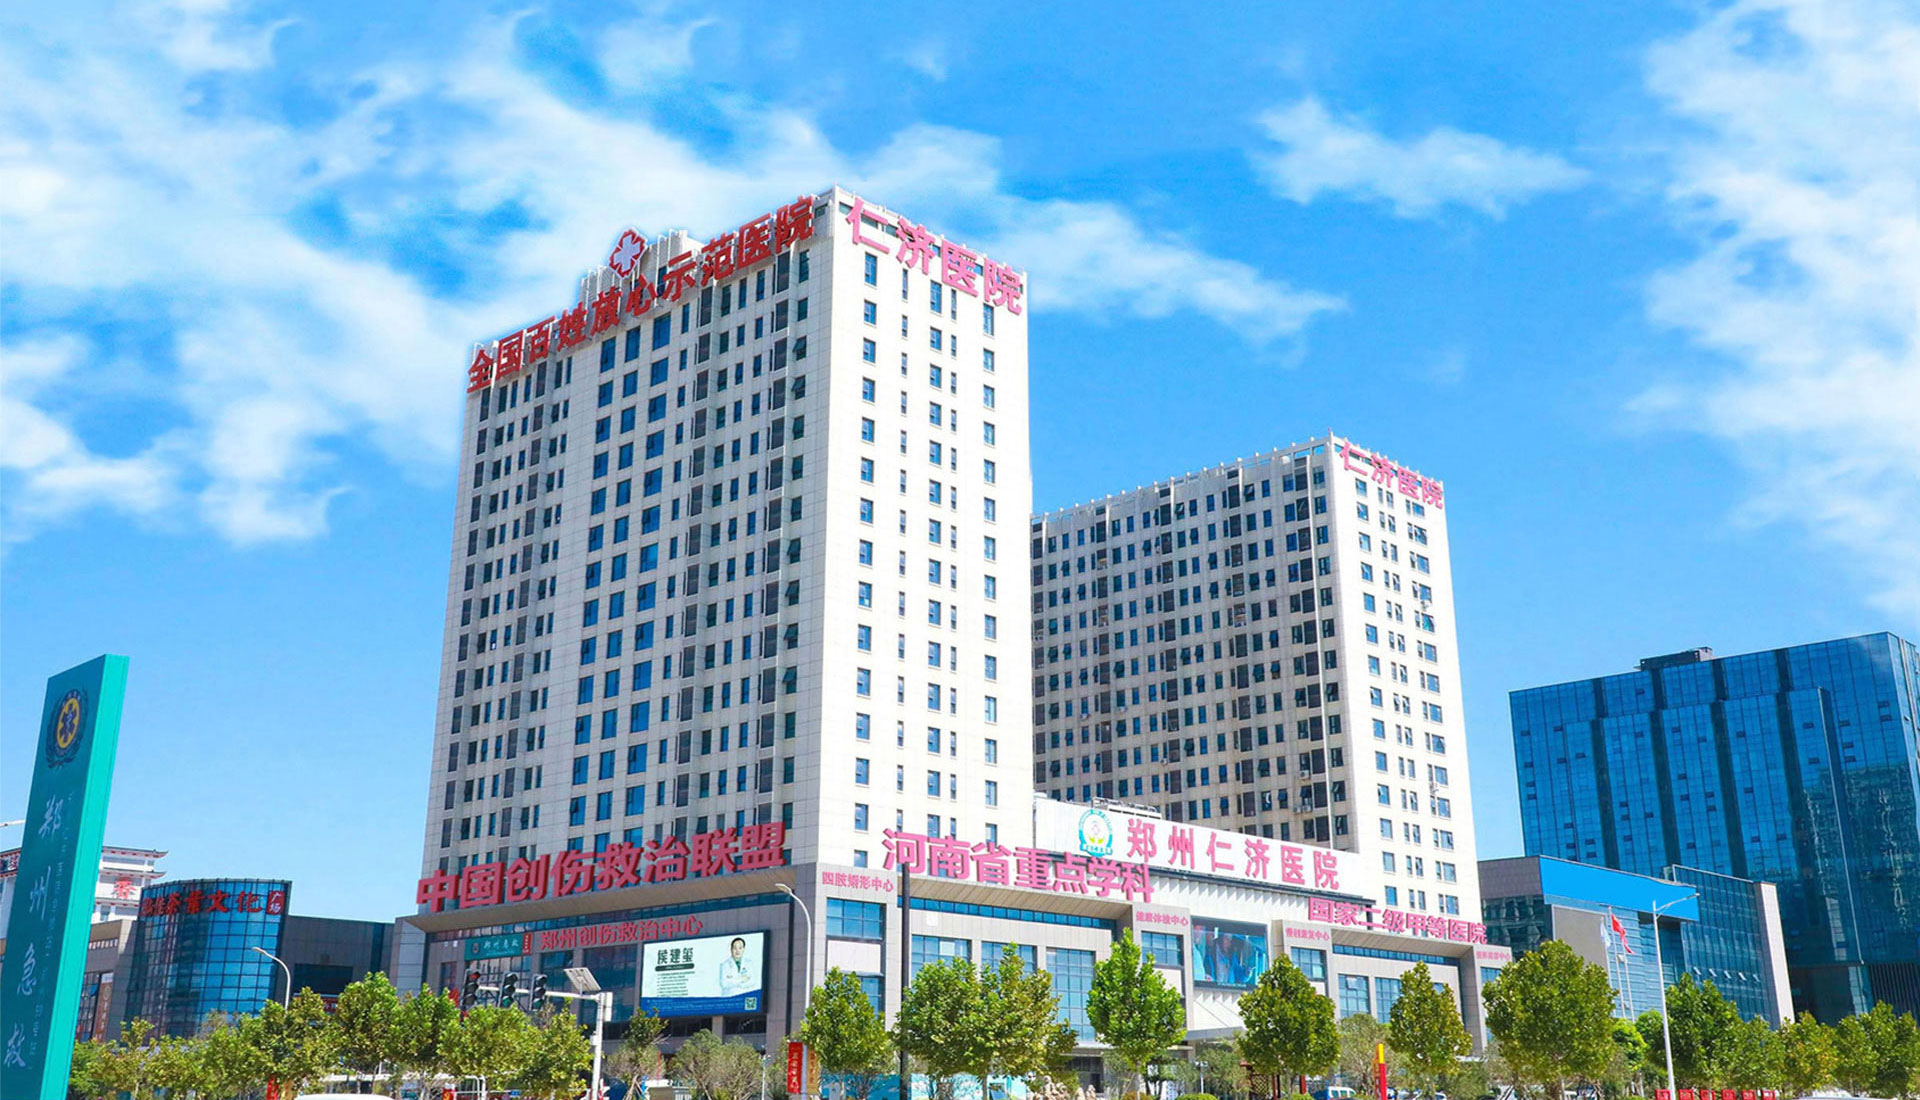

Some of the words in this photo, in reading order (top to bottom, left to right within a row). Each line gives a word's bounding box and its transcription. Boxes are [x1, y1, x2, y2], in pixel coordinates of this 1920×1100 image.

[846, 197, 1022, 315] 仁济医院
[467, 194, 815, 392] 全国百姓放心示范医院
[1340, 441, 1443, 510] 仁济医院
[416, 821, 787, 912] 中国创伤救治联盟
[882, 828, 1154, 903] 河南省重点学科
[1127, 818, 1339, 890] 郑州仁济医院
[540, 915, 703, 950] 郑州创伤救治中心
[1308, 896, 1487, 945] 国家二级甲等医院
